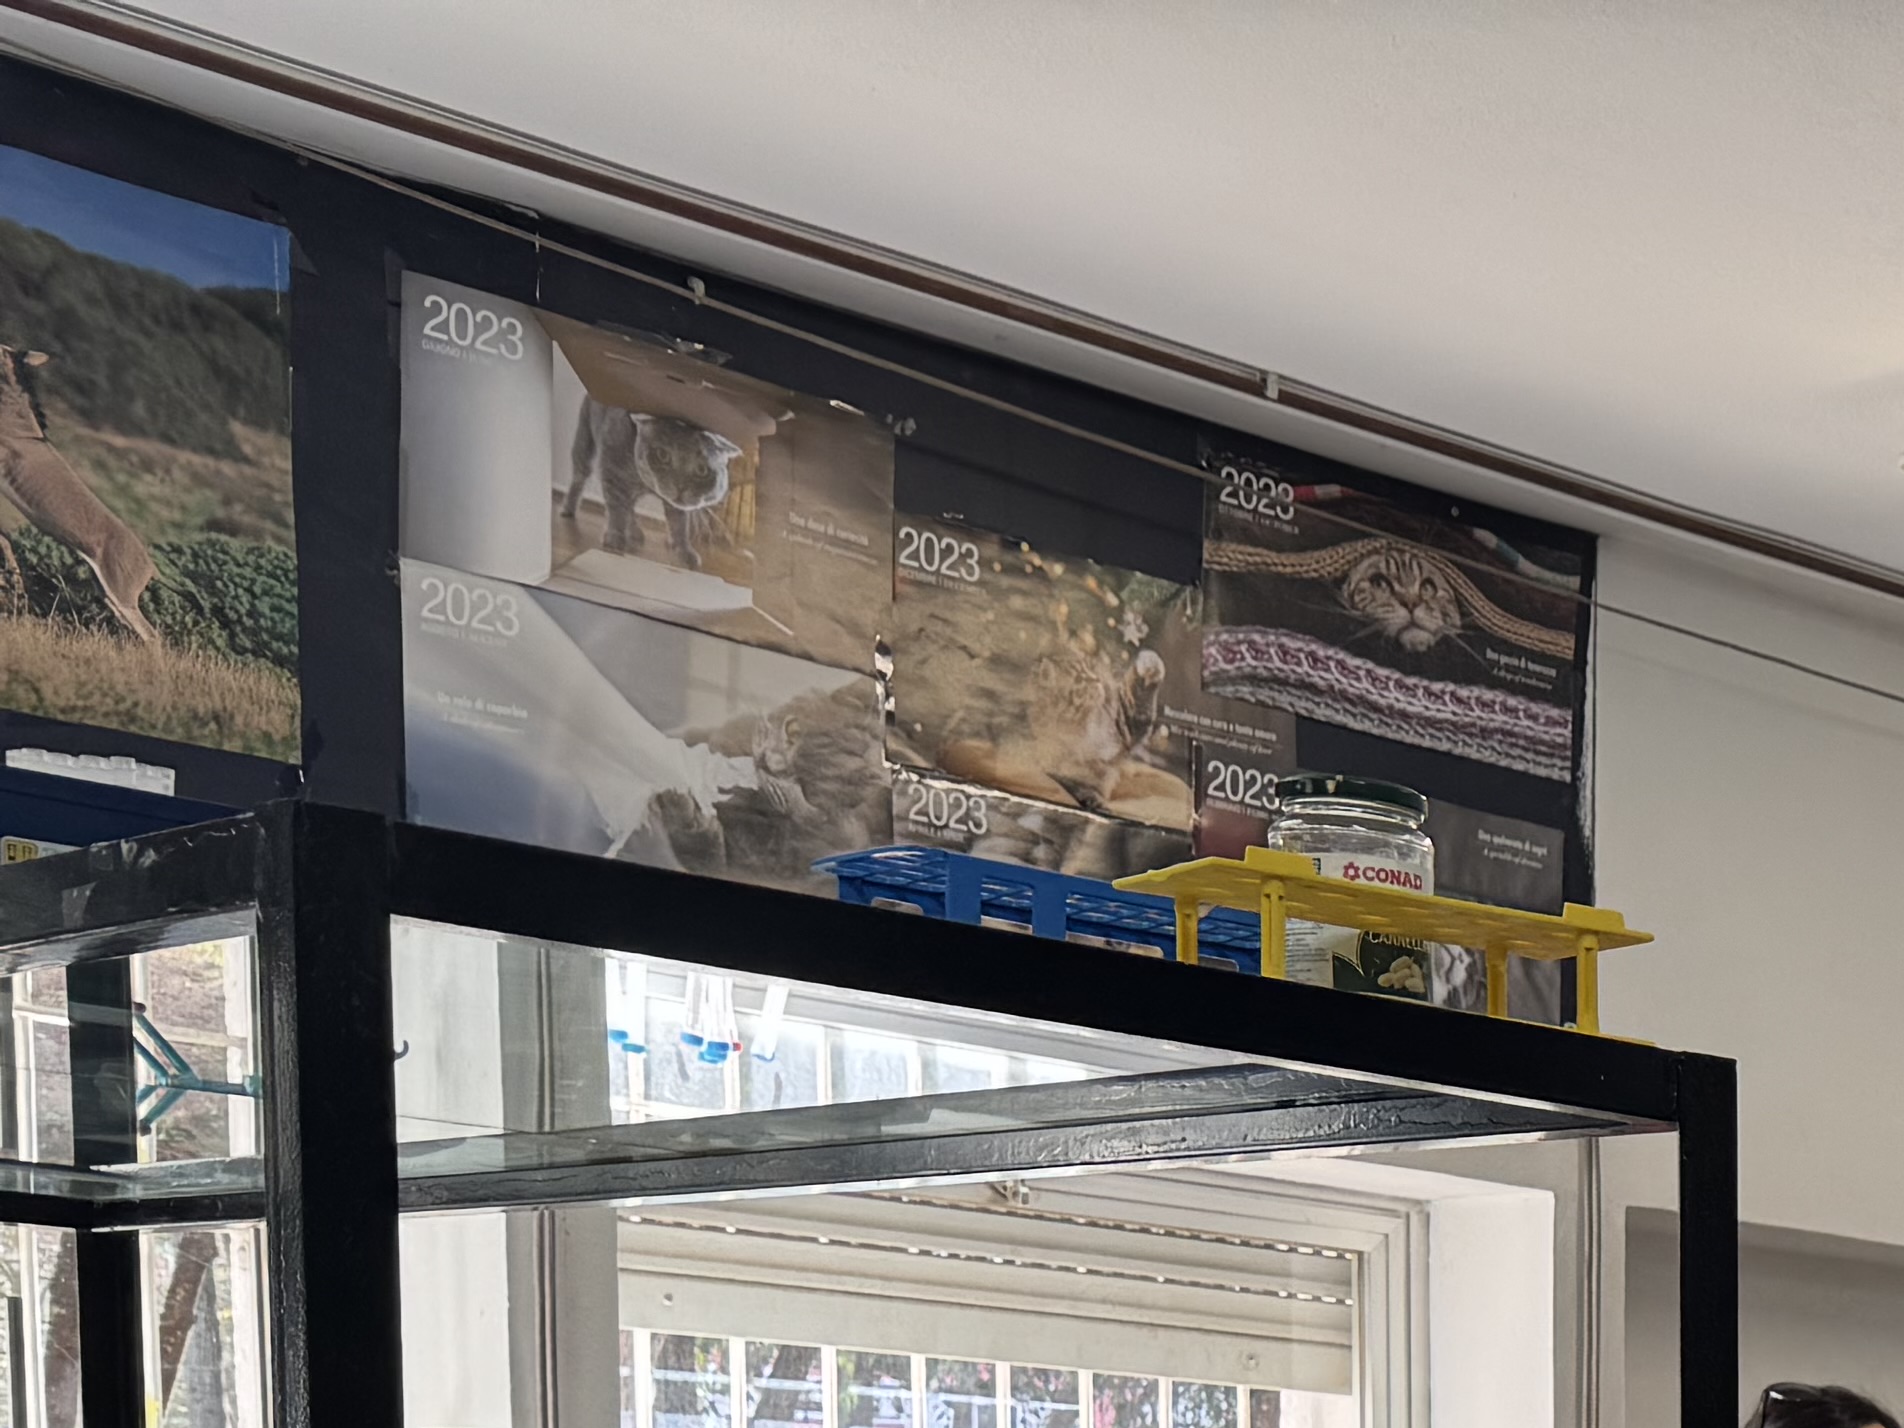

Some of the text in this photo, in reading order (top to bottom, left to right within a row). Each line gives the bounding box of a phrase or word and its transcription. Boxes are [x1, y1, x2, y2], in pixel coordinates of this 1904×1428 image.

[423, 294, 523, 360] 2023
[1220, 465, 1294, 520] 2023
[899, 526, 980, 582] 2023
[420, 577, 520, 636] 2023
[908, 783, 988, 835] 2023
[1207, 760, 1280, 810] 2023
[1362, 866, 1422, 890] CONAD
